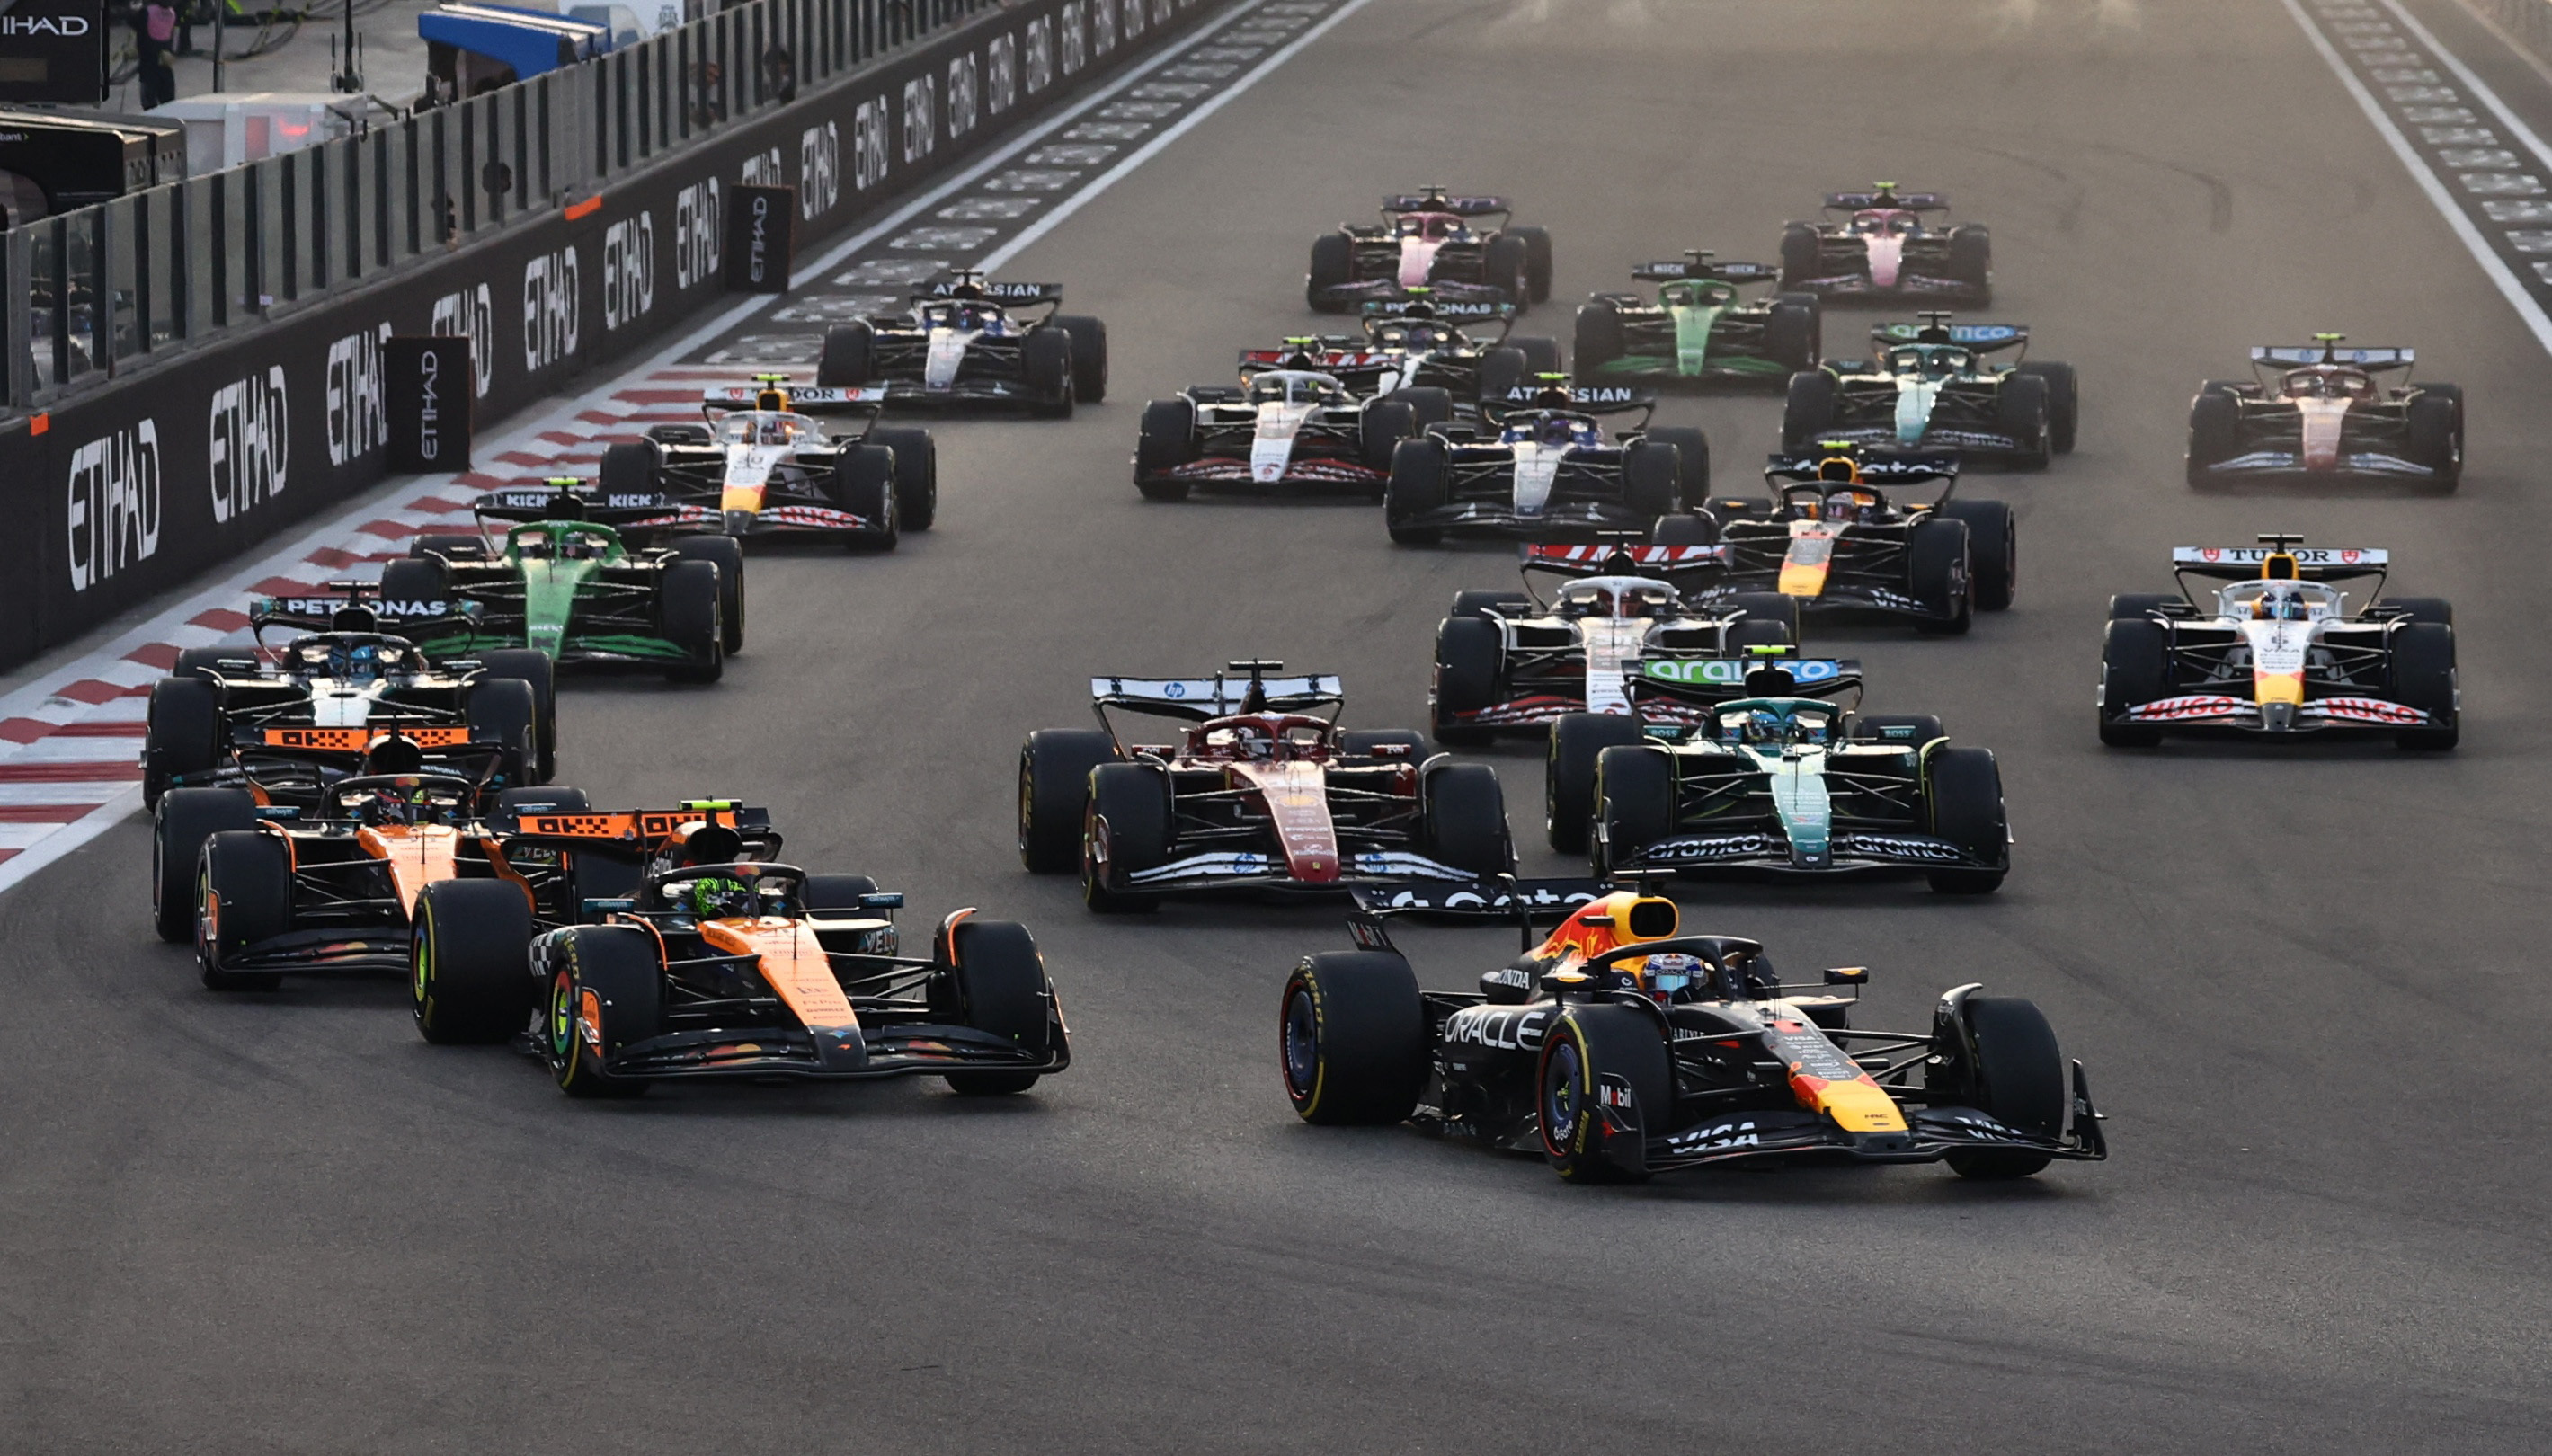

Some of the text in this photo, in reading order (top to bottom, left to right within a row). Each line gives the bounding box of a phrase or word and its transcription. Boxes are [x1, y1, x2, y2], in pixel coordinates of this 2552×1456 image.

[751, 196, 767, 283] ETIHAD
[604, 210, 654, 331] ETIHAD
[524, 245, 579, 372] ETIHAD
[421, 351, 438, 460] ETIHAD
[210, 364, 289, 523] ETIHAD
[67, 417, 161, 592] ETIHAD
[506, 494, 548, 507] KICK
[609, 494, 652, 507] KICK
[2230, 549, 2331, 562] TUOR
[288, 599, 447, 617] PETONAS
[2141, 697, 2236, 719] HUGO
[2325, 697, 2420, 724] HUGO
[537, 818, 609, 835] OKX
[1648, 834, 1762, 860] aramco
[1496, 968, 1530, 990] ONDA
[1445, 1010, 1546, 1052] ORACLE
[1600, 1085, 1632, 1108] Mobil
[1667, 1121, 1759, 1154] VISA
